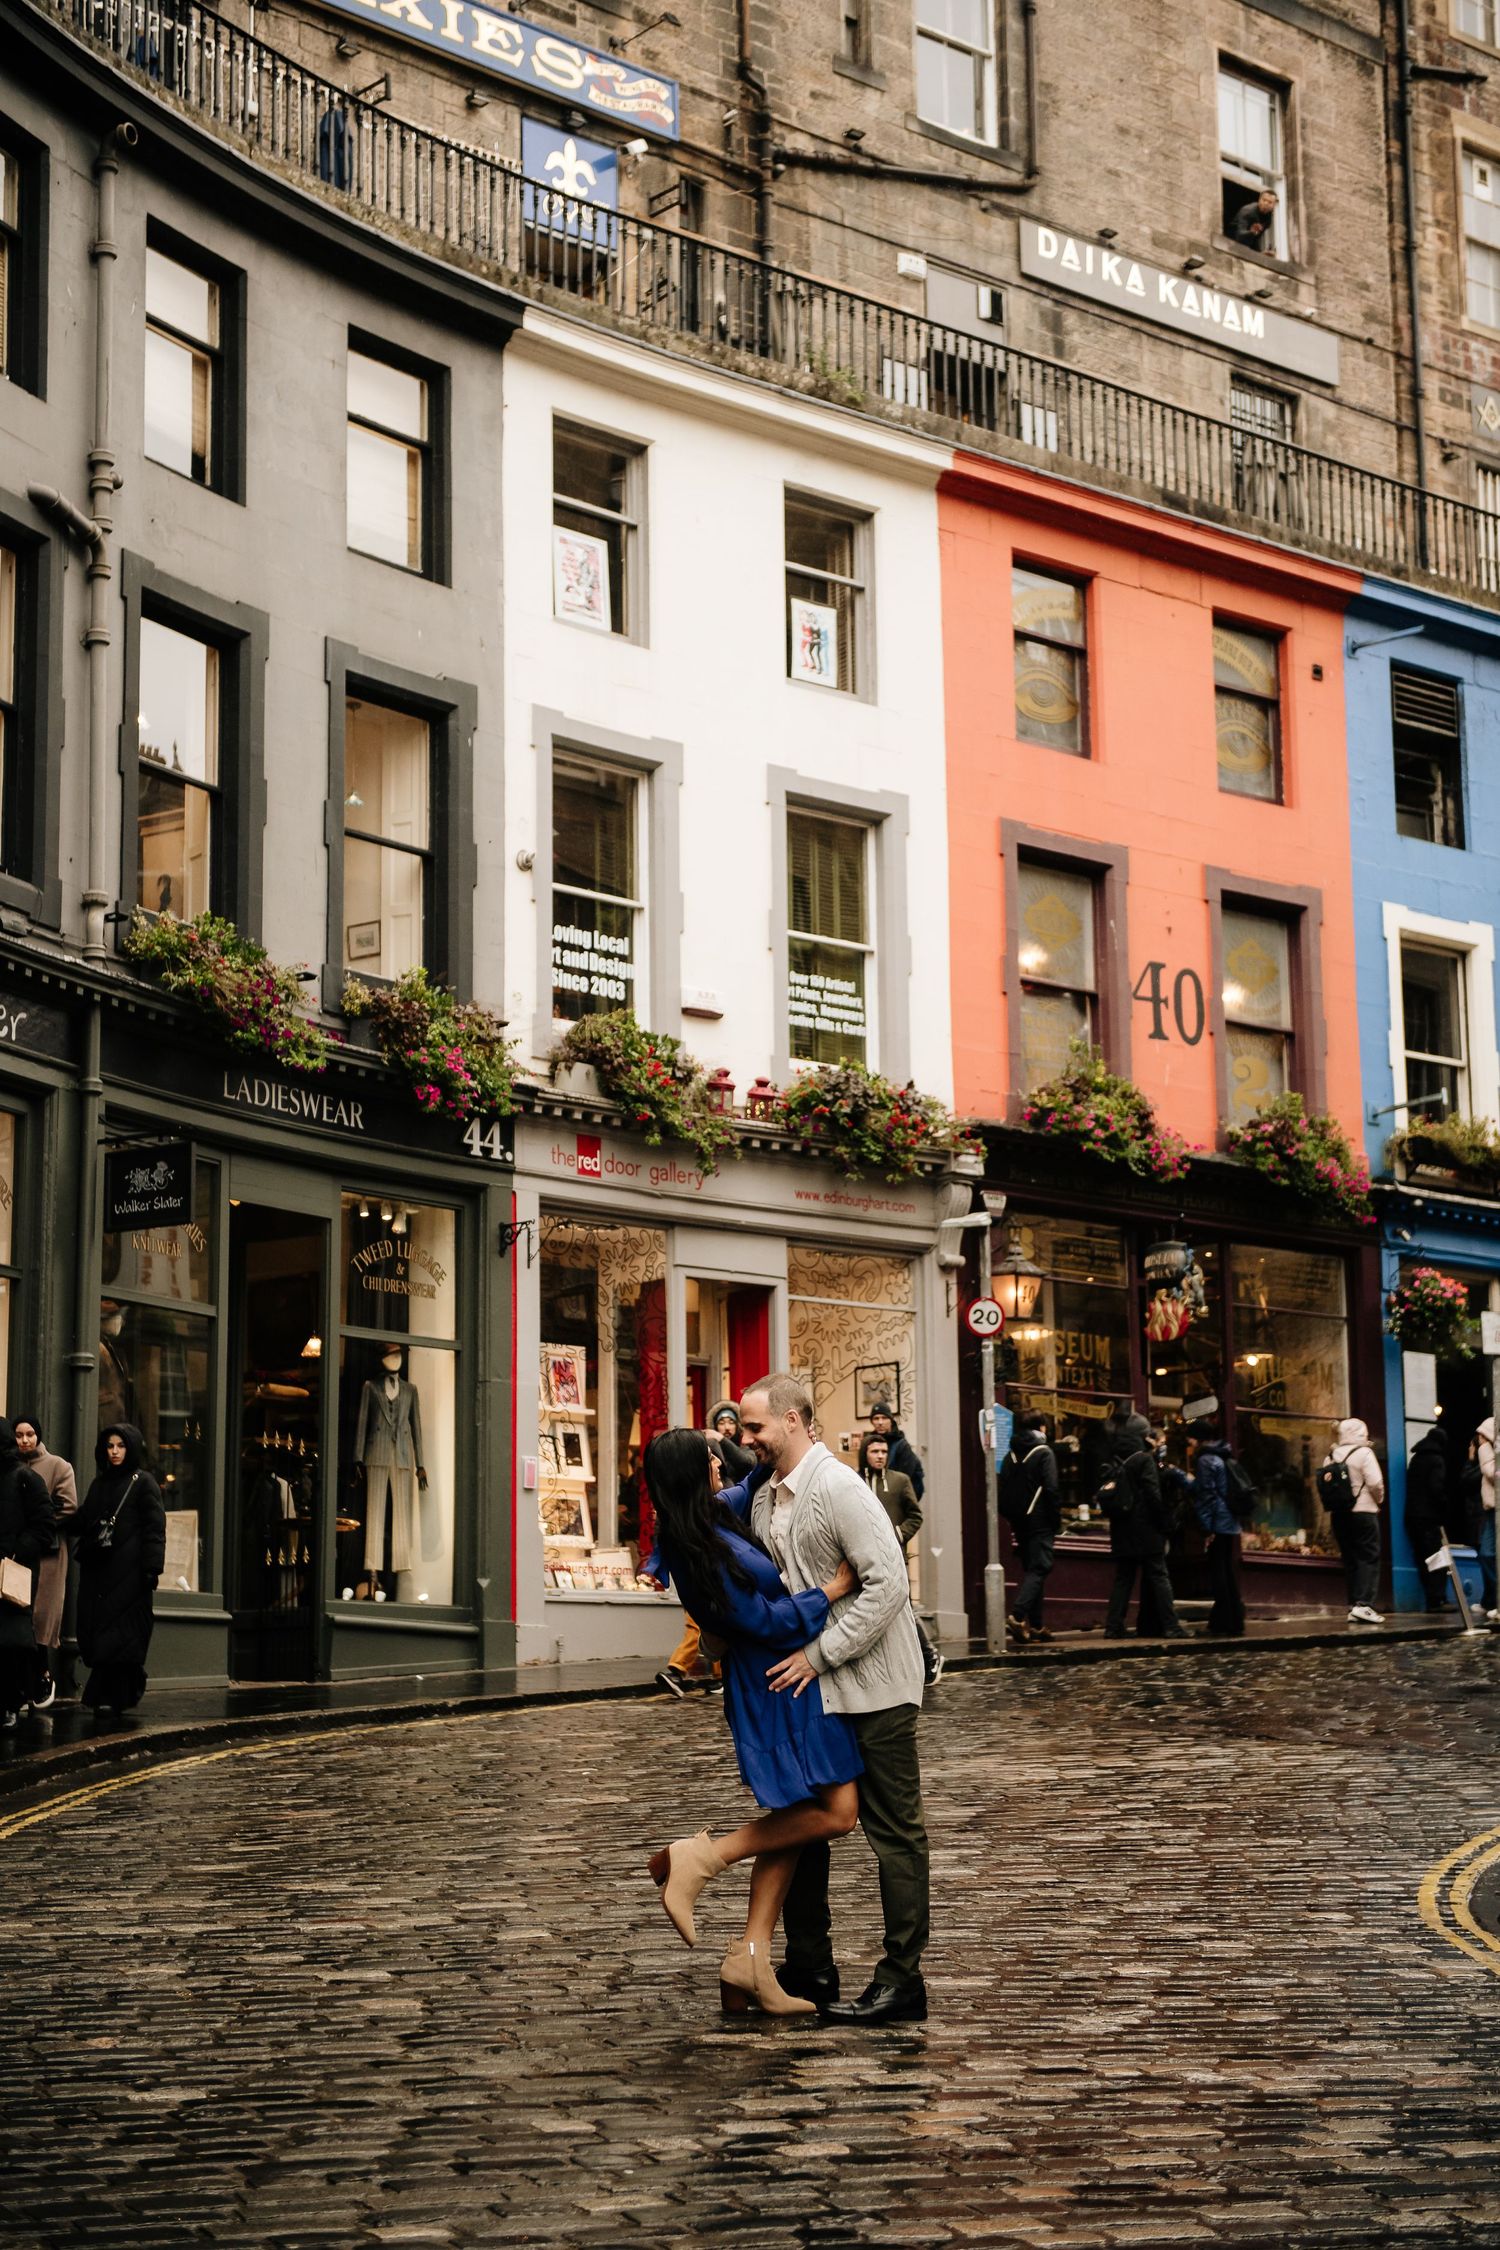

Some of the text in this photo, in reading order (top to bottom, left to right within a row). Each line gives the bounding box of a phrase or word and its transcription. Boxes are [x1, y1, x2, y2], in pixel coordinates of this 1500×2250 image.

[1037, 226, 1265, 338] DAIKA KANAM
[552, 924, 630, 955] oving Local
[562, 949, 588, 971] and
[589, 952, 635, 980] Design
[552, 967, 626, 1001] Since 2003
[1132, 961, 1205, 1046] 40
[223, 1071, 365, 1129] LADIESWEAR
[551, 1144, 706, 1190] the red door gallery
[114, 1196, 184, 1215] Walker Slater
[794, 1189, 917, 1213] www.edinburghart.com
[131, 1232, 182, 1257] KNITWEAR
[350, 1239, 447, 1287] TWEED LUGGAGE
[395, 1262, 405, 1276] &
[362, 1275, 437, 1299] CHILDRENSWEAR
[972, 1308, 999, 1326] 20
